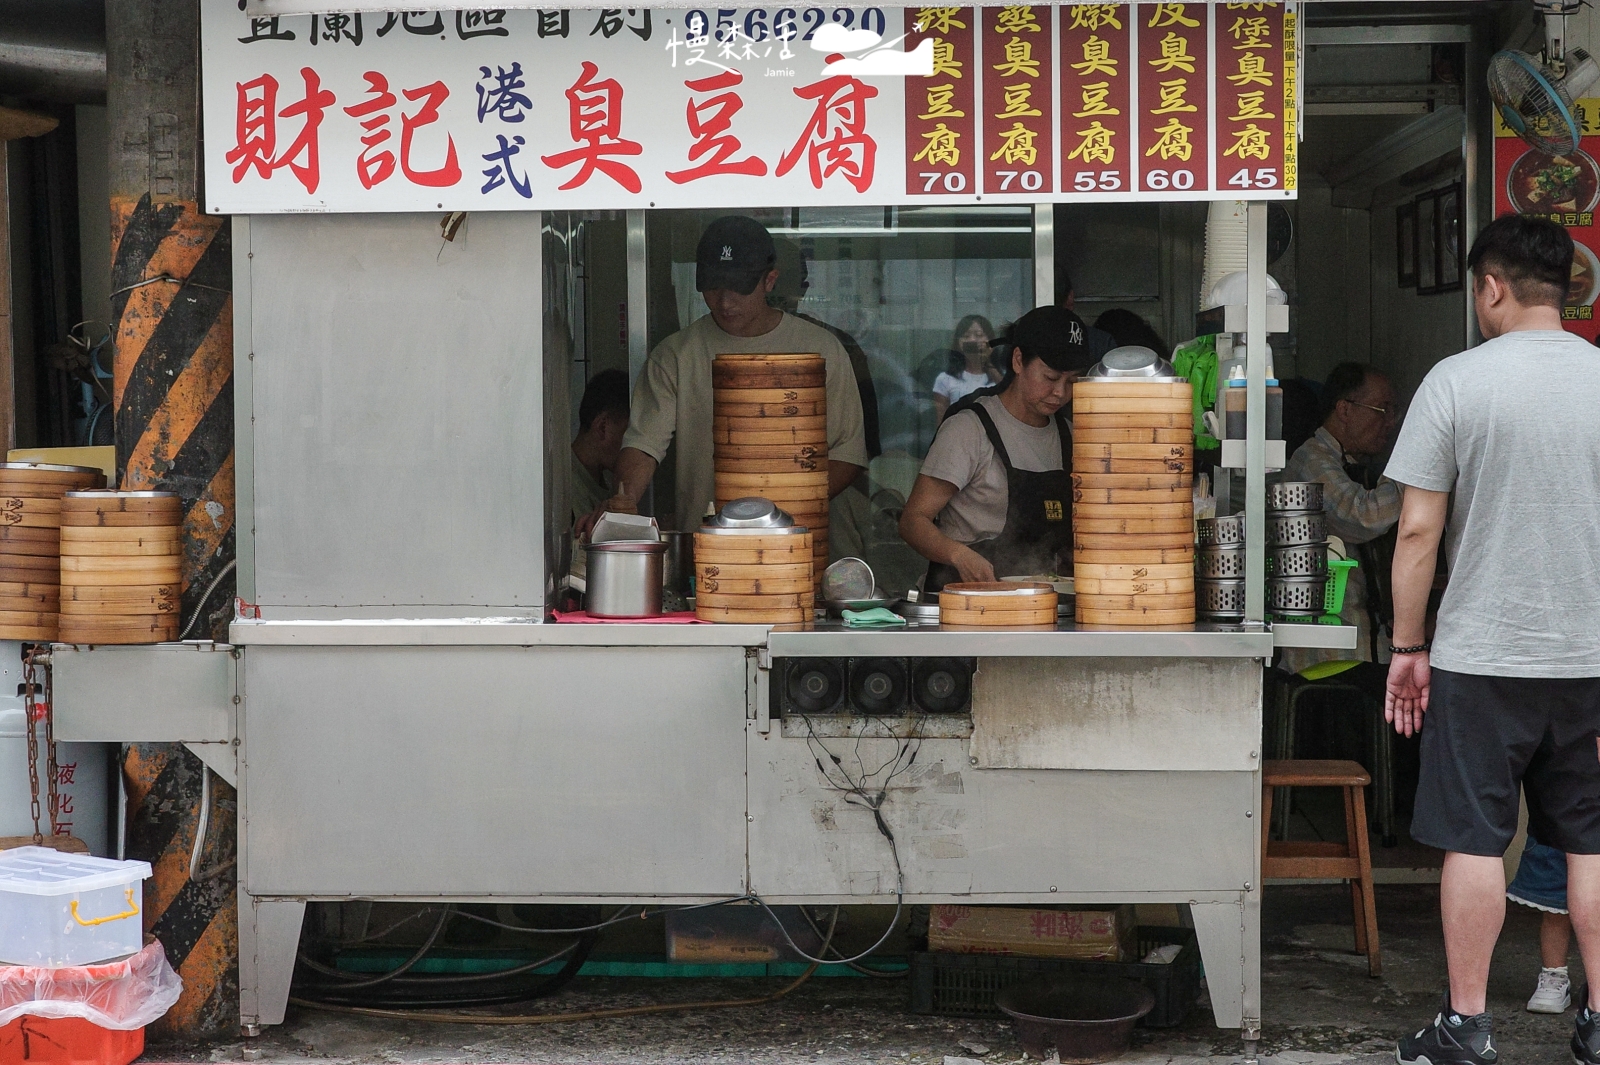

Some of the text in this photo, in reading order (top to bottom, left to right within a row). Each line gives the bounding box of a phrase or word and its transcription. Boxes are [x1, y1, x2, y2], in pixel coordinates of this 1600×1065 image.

[226, 53, 878, 199] 財記 港式 臭豆腐
[919, 172, 966, 192] 70
[995, 171, 1043, 191] 70
[1074, 170, 1122, 191] 55
[1146, 169, 1195, 190] 60
[1228, 168, 1278, 188] 45
